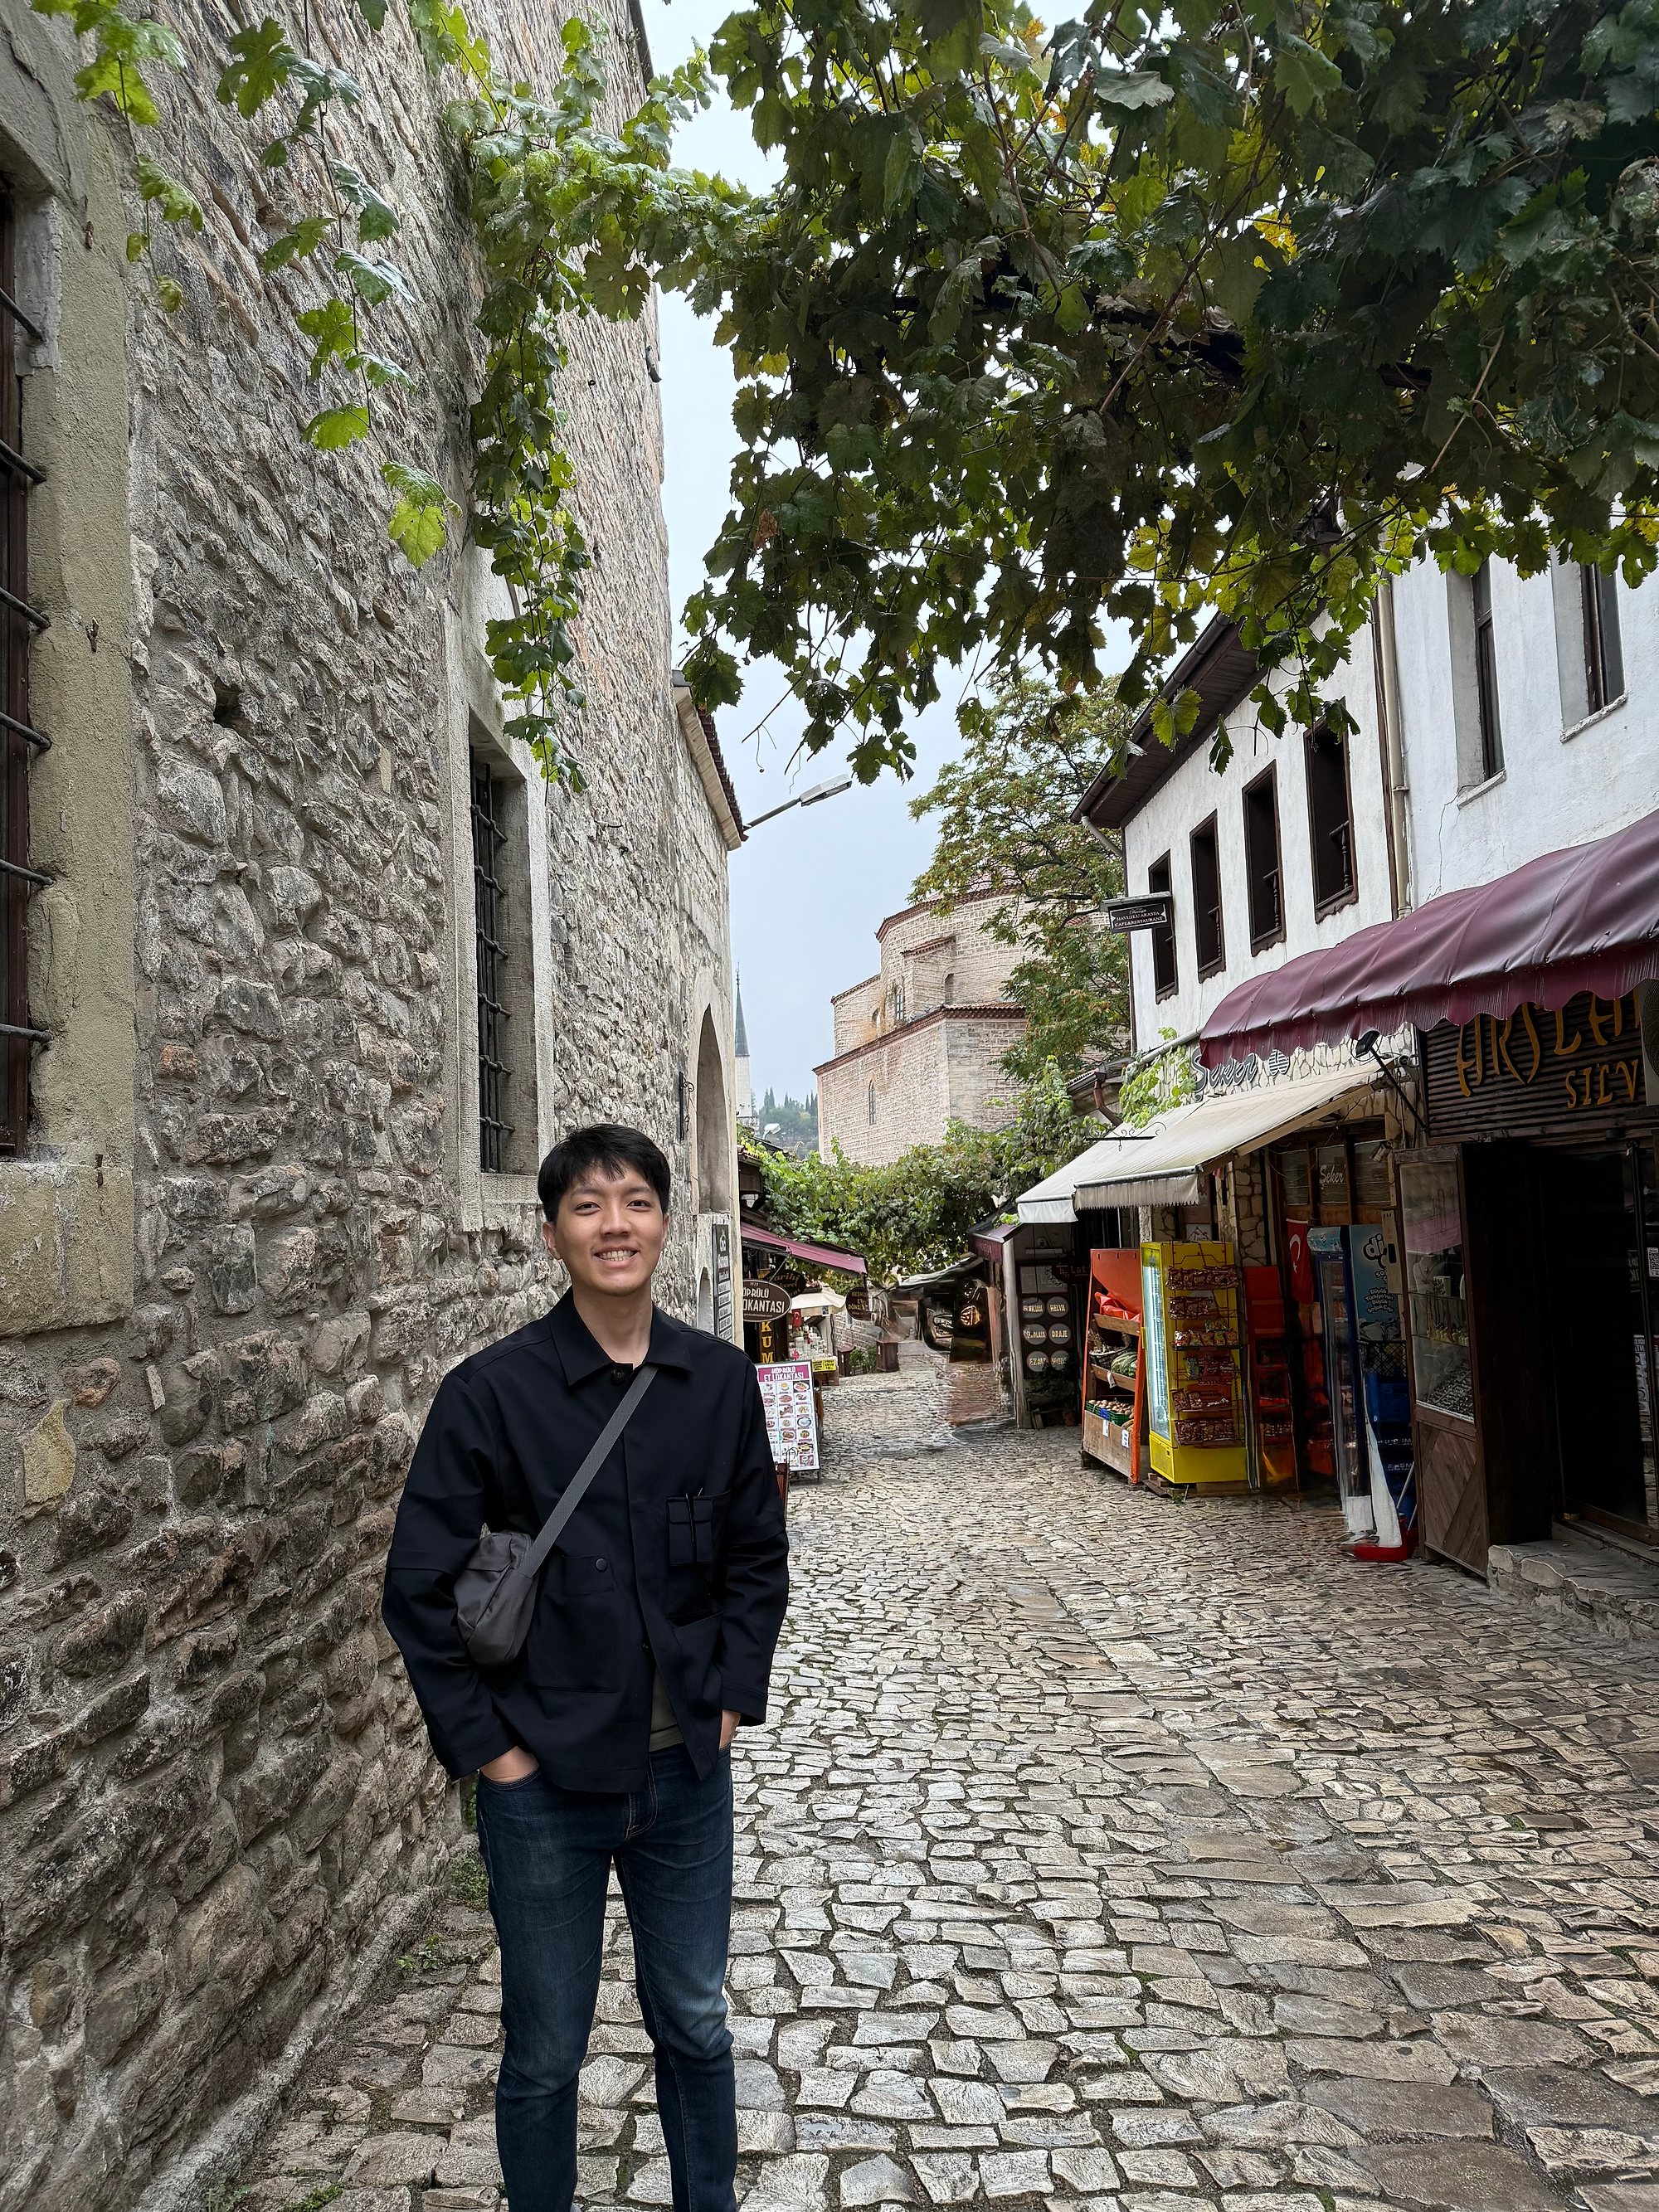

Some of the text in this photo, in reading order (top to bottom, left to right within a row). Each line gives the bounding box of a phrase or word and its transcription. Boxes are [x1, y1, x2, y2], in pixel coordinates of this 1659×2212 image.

[1456, 989, 1640, 1097] ARSLA
[1565, 1058, 1639, 1109] SILV
[743, 1286, 770, 1299] ÖPRÜLÜ
[743, 1298, 785, 1314] OKANTASI
[1049, 1304, 1066, 1312] HELVA
